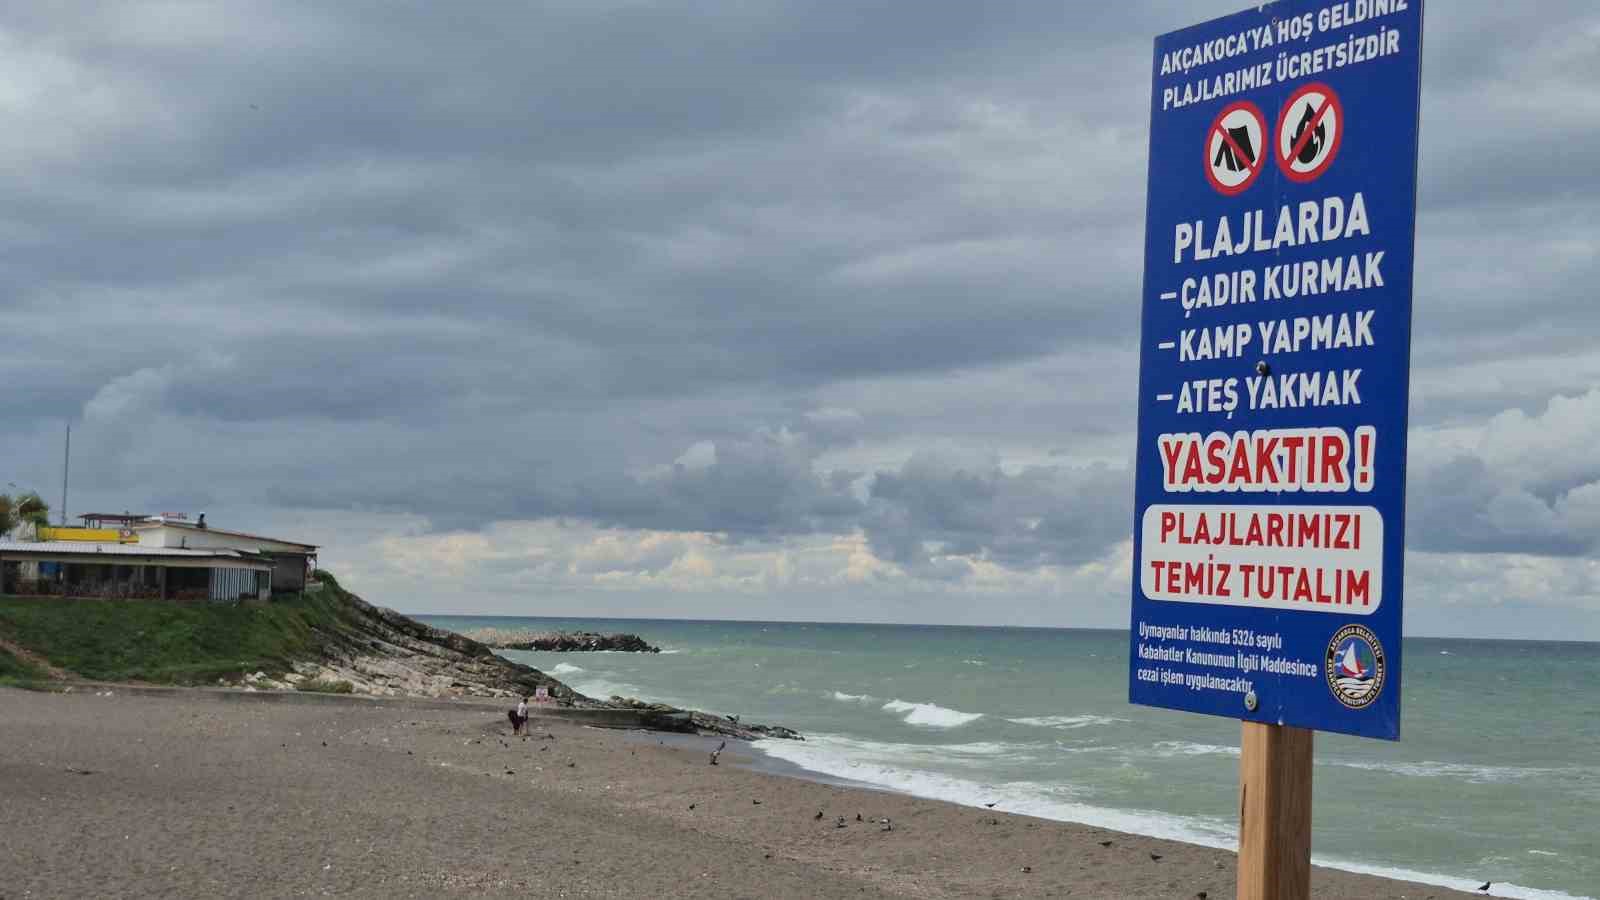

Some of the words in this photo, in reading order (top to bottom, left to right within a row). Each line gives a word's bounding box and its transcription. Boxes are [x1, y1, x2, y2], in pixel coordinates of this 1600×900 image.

[1160, 24, 1273, 76] AKÇAKOCA'YA
[1277, 12, 1313, 42] HOŞ
[1163, 63, 1272, 110] PLAJLARIMIZ
[1276, 25, 1400, 82] ÜCRETSİZDİR
[1174, 192, 1370, 264] PLAJLARDA
[1263, 251, 1385, 300] KURMAK
[1258, 309, 1375, 354] YAPMAK
[1245, 368, 1362, 410] YAKMAK
[1160, 512, 1361, 550] PLAJLARIMIZI
[1151, 554, 1232, 597] TEMİZ
[1240, 564, 1370, 606] TUTALIM
[1139, 621, 1189, 641] Uymayanlar
[1190, 625, 1231, 645] hakkında
[1232, 628, 1255, 647] 5326
[1256, 632, 1282, 652] sayılı
[1137, 667, 1159, 682] cezai
[1160, 667, 1184, 686] işlem
[1138, 643, 1184, 662] Kabahatler
[1186, 647, 1235, 669] Kanununun
[1237, 649, 1259, 673] İlgili
[1260, 655, 1317, 677] Maddesince
